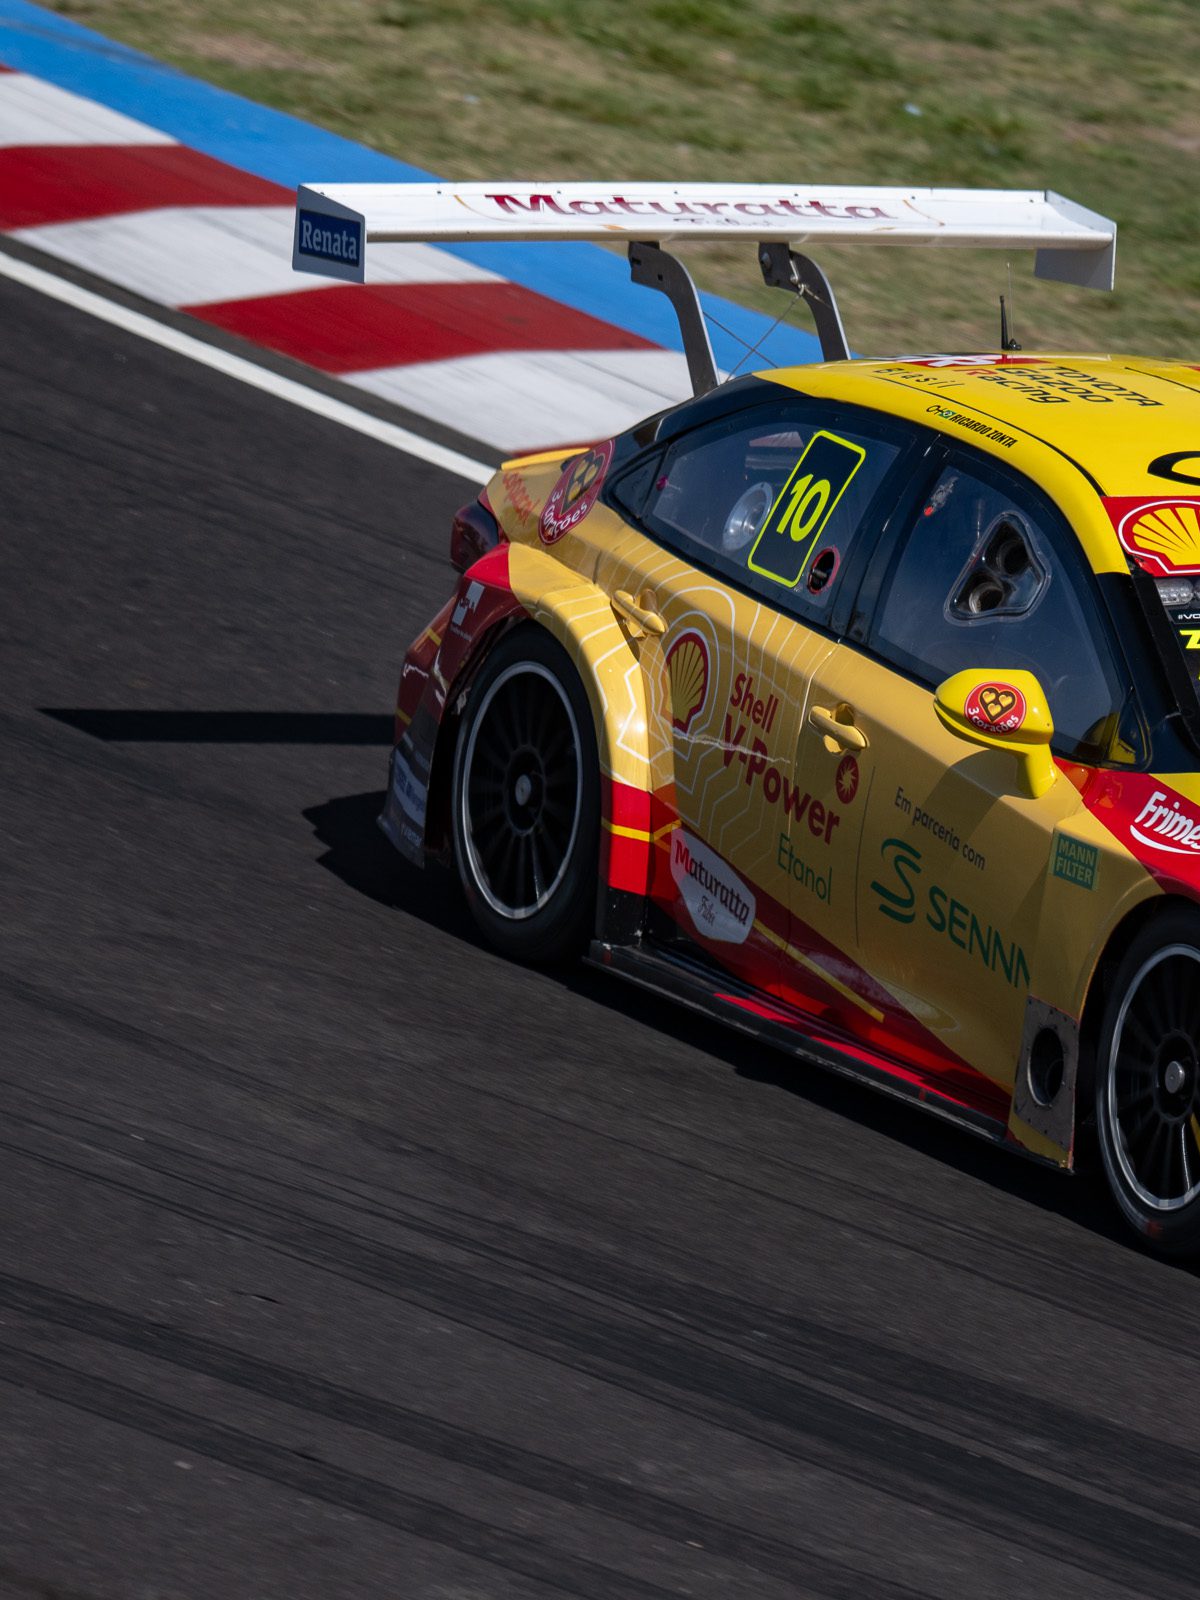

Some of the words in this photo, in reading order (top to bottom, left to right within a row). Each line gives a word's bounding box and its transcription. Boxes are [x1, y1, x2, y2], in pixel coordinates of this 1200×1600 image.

[485, 194, 898, 219] Maturatta
[301, 219, 358, 261] Renata
[995, 367, 1114, 403] GAZOO
[1038, 366, 1166, 407] TOYOTA
[949, 413, 992, 436] RICARDO
[986, 429, 1018, 448] ZONTA
[776, 473, 831, 542] 10
[729, 673, 779, 733] Shell
[968, 707, 979, 715] 3
[972, 714, 1019, 733] corações
[723, 713, 840, 845] V-Power
[894, 787, 912, 815] Em
[912, 805, 960, 851] parceria
[962, 843, 986, 870] com
[777, 832, 832, 905] Etanol
[1056, 857, 1093, 886] FILTER
[1058, 838, 1096, 866] MANN
[674, 839, 750, 926] Maturatta
